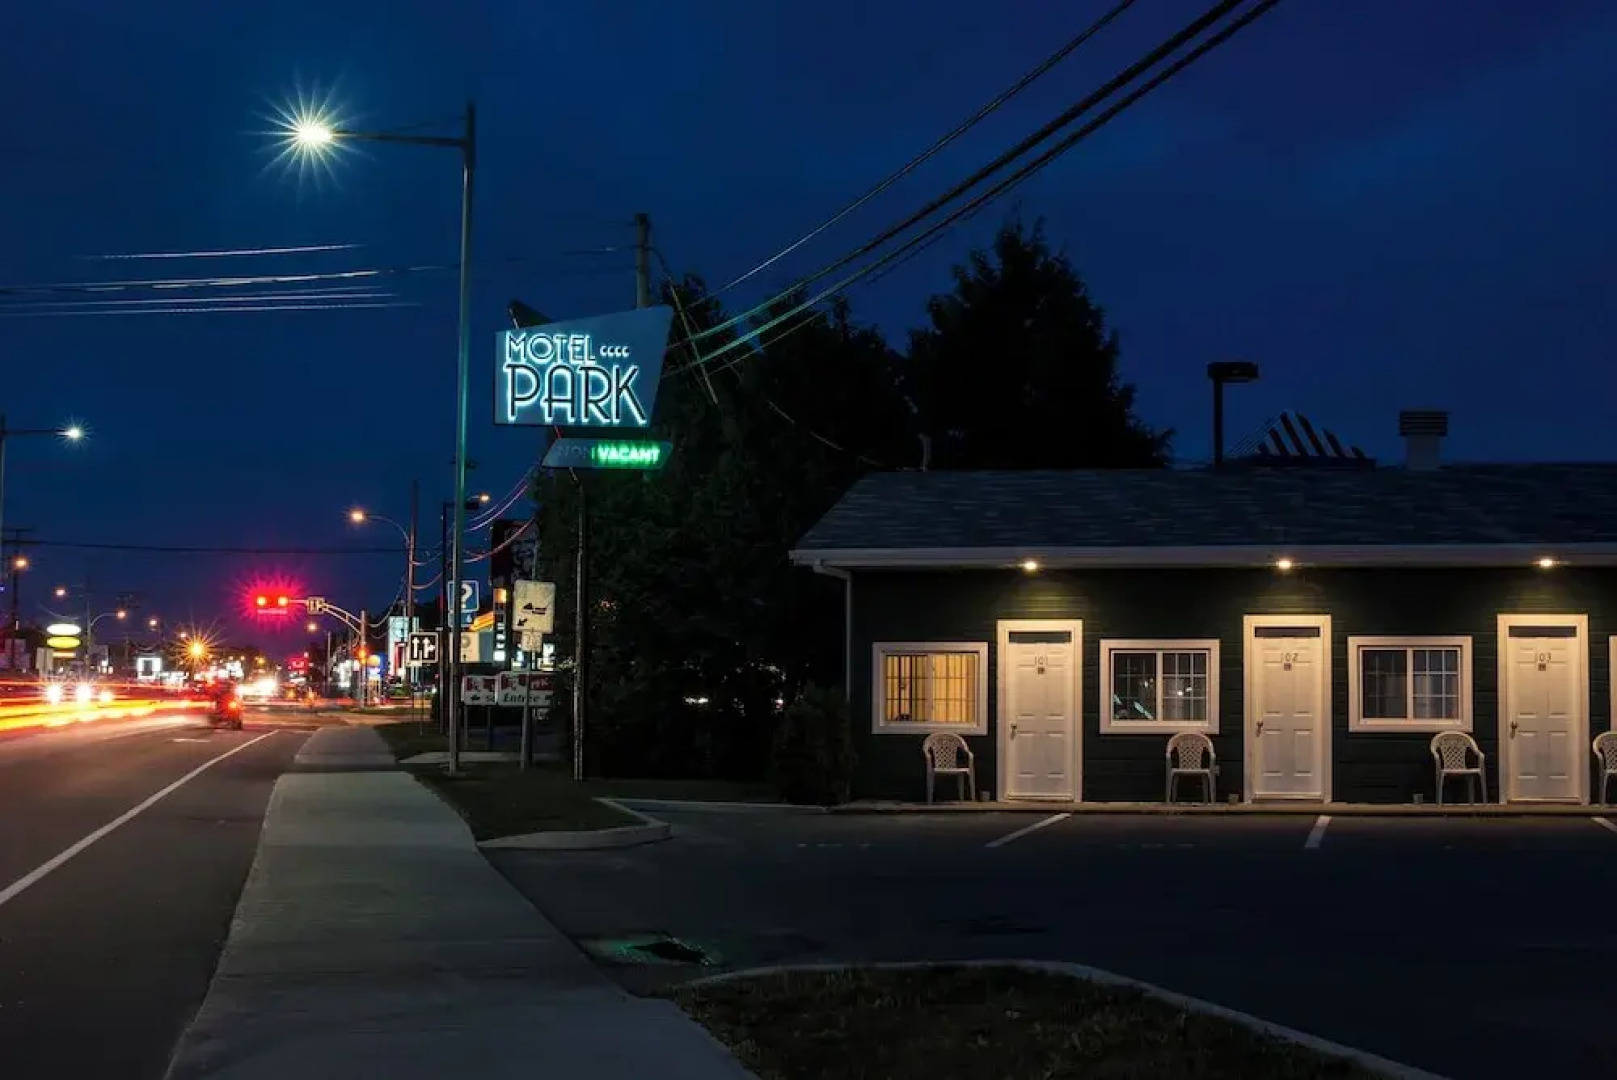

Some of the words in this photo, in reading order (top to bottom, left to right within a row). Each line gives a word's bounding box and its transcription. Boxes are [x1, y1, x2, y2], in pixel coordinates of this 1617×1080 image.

[504, 331, 596, 365] MOTEL
[503, 362, 648, 425] PARK
[598, 445, 661, 463] VACANT
[1281, 653, 1298, 662] 102
[1535, 653, 1551, 662] 103
